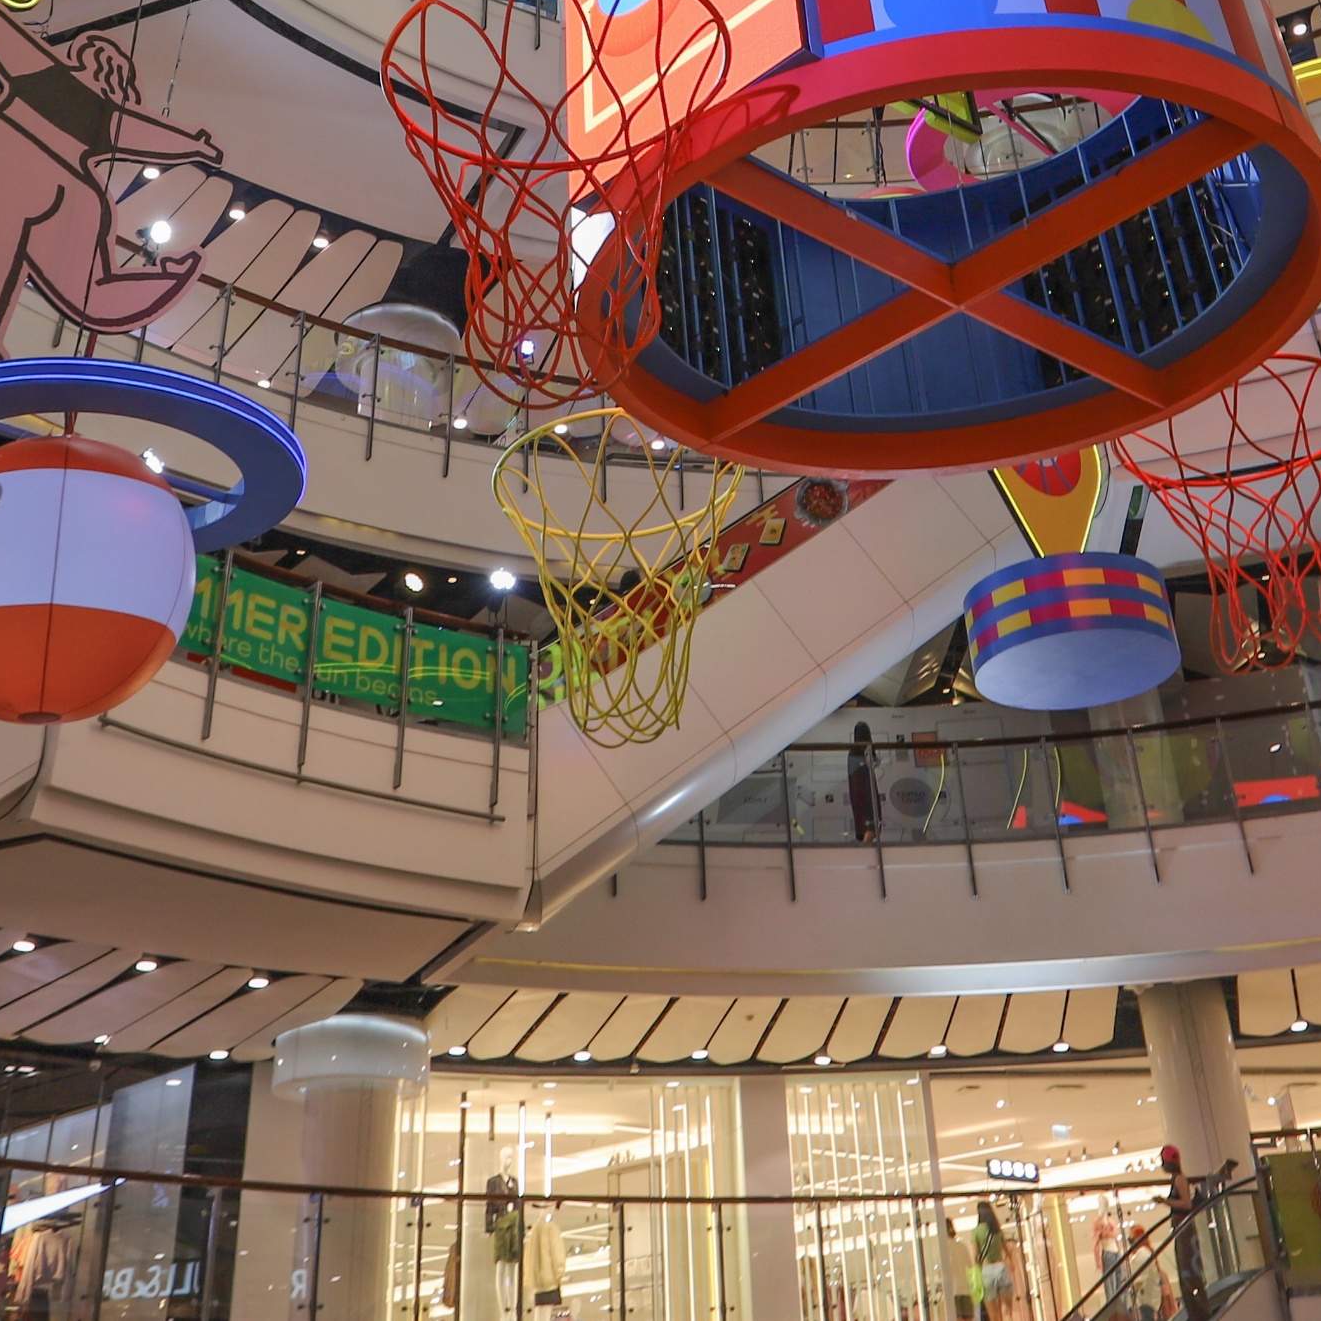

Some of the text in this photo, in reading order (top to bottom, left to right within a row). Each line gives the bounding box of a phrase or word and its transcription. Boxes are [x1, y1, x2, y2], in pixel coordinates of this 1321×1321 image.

[258, 641, 300, 672] the
[355, 669, 438, 705] begns
[322, 615, 516, 695] EDITION
